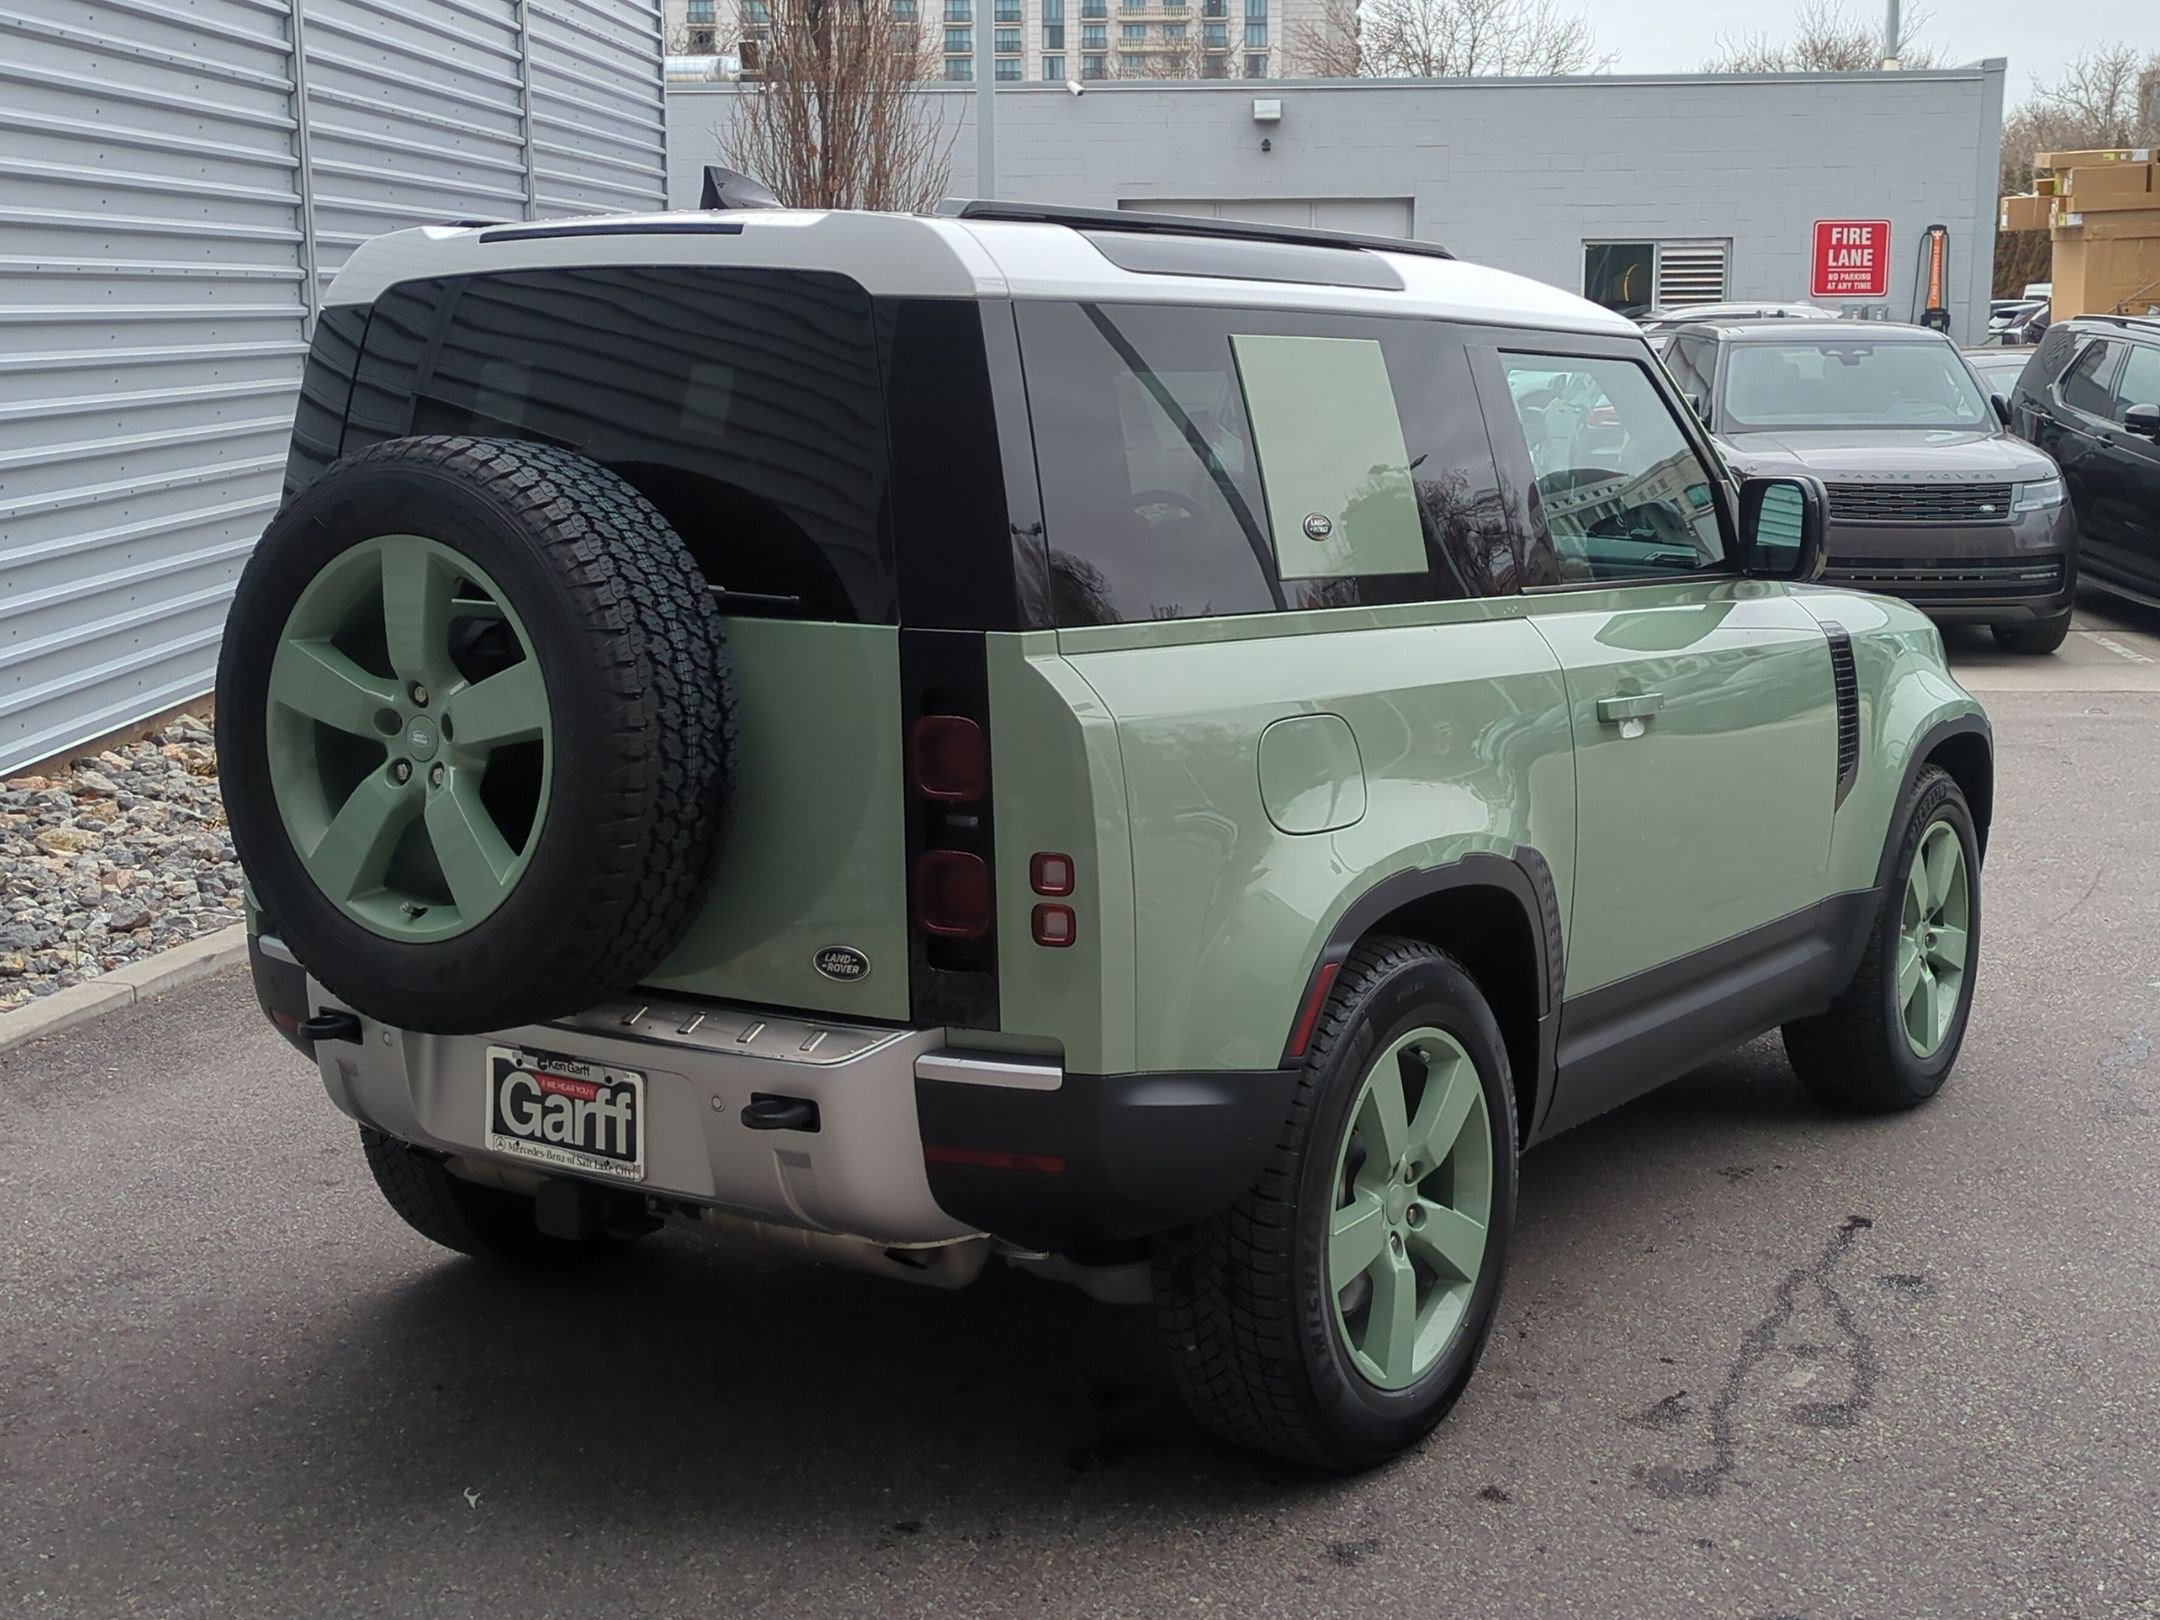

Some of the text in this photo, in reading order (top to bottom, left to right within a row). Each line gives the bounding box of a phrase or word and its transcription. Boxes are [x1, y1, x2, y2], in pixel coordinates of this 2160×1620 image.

[1831, 227, 1872, 245] FIRE
[1828, 249, 1873, 267] LANE
[1828, 273, 1871, 281] NO PARKING
[824, 953, 851, 964] LAND
[827, 963, 860, 974] ROVER
[548, 1060, 590, 1077] Ken Garff
[500, 1071, 632, 1155] Garff
